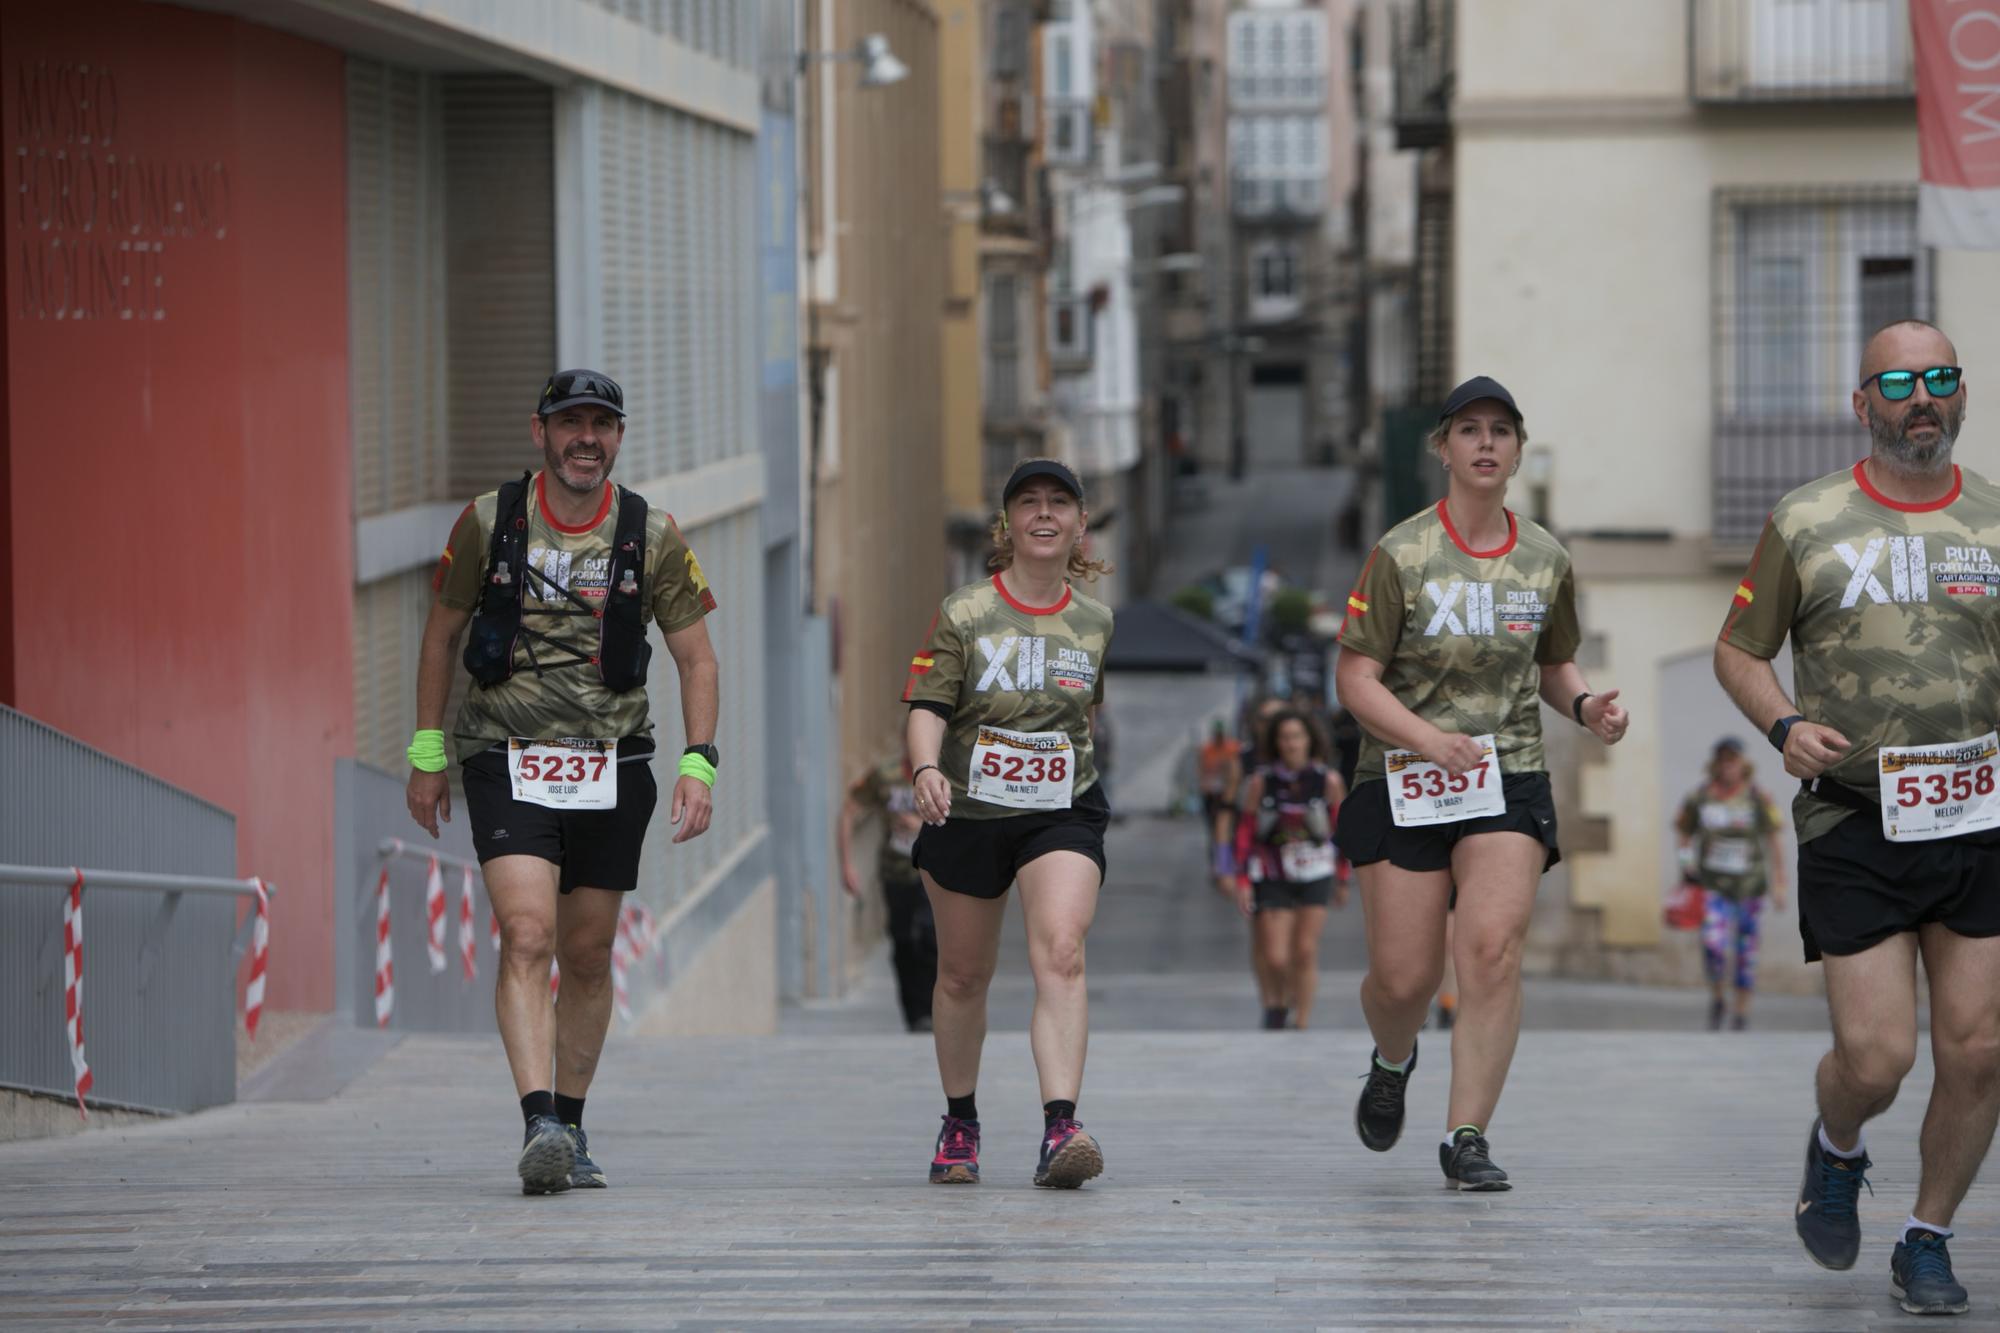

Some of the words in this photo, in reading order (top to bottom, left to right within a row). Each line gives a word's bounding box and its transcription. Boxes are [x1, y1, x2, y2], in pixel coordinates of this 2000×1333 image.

[1946, 0, 2000, 144] OM
[17, 236, 165, 321] MOLINETE
[1945, 546, 1992, 563] RUTA
[1832, 536, 1929, 608] XII
[1423, 581, 1495, 635] XII
[1506, 591, 1540, 603] RUTA
[975, 635, 1045, 692] XII
[1058, 647, 1090, 664] RUTA
[571, 739, 598, 749] 2023
[1033, 740, 1057, 750] 2023
[520, 754, 609, 782] 5237
[980, 751, 1067, 783] 5238
[547, 785, 562, 794] JOSE
[564, 785, 578, 794] LUIS
[1005, 783, 1019, 793] ANA
[1020, 784, 1039, 794] NIETO
[1402, 761, 1490, 800] 5357
[1896, 764, 1995, 808] 5358
[1445, 796, 1464, 807] MARY
[1934, 805, 1964, 818] MELCHY
